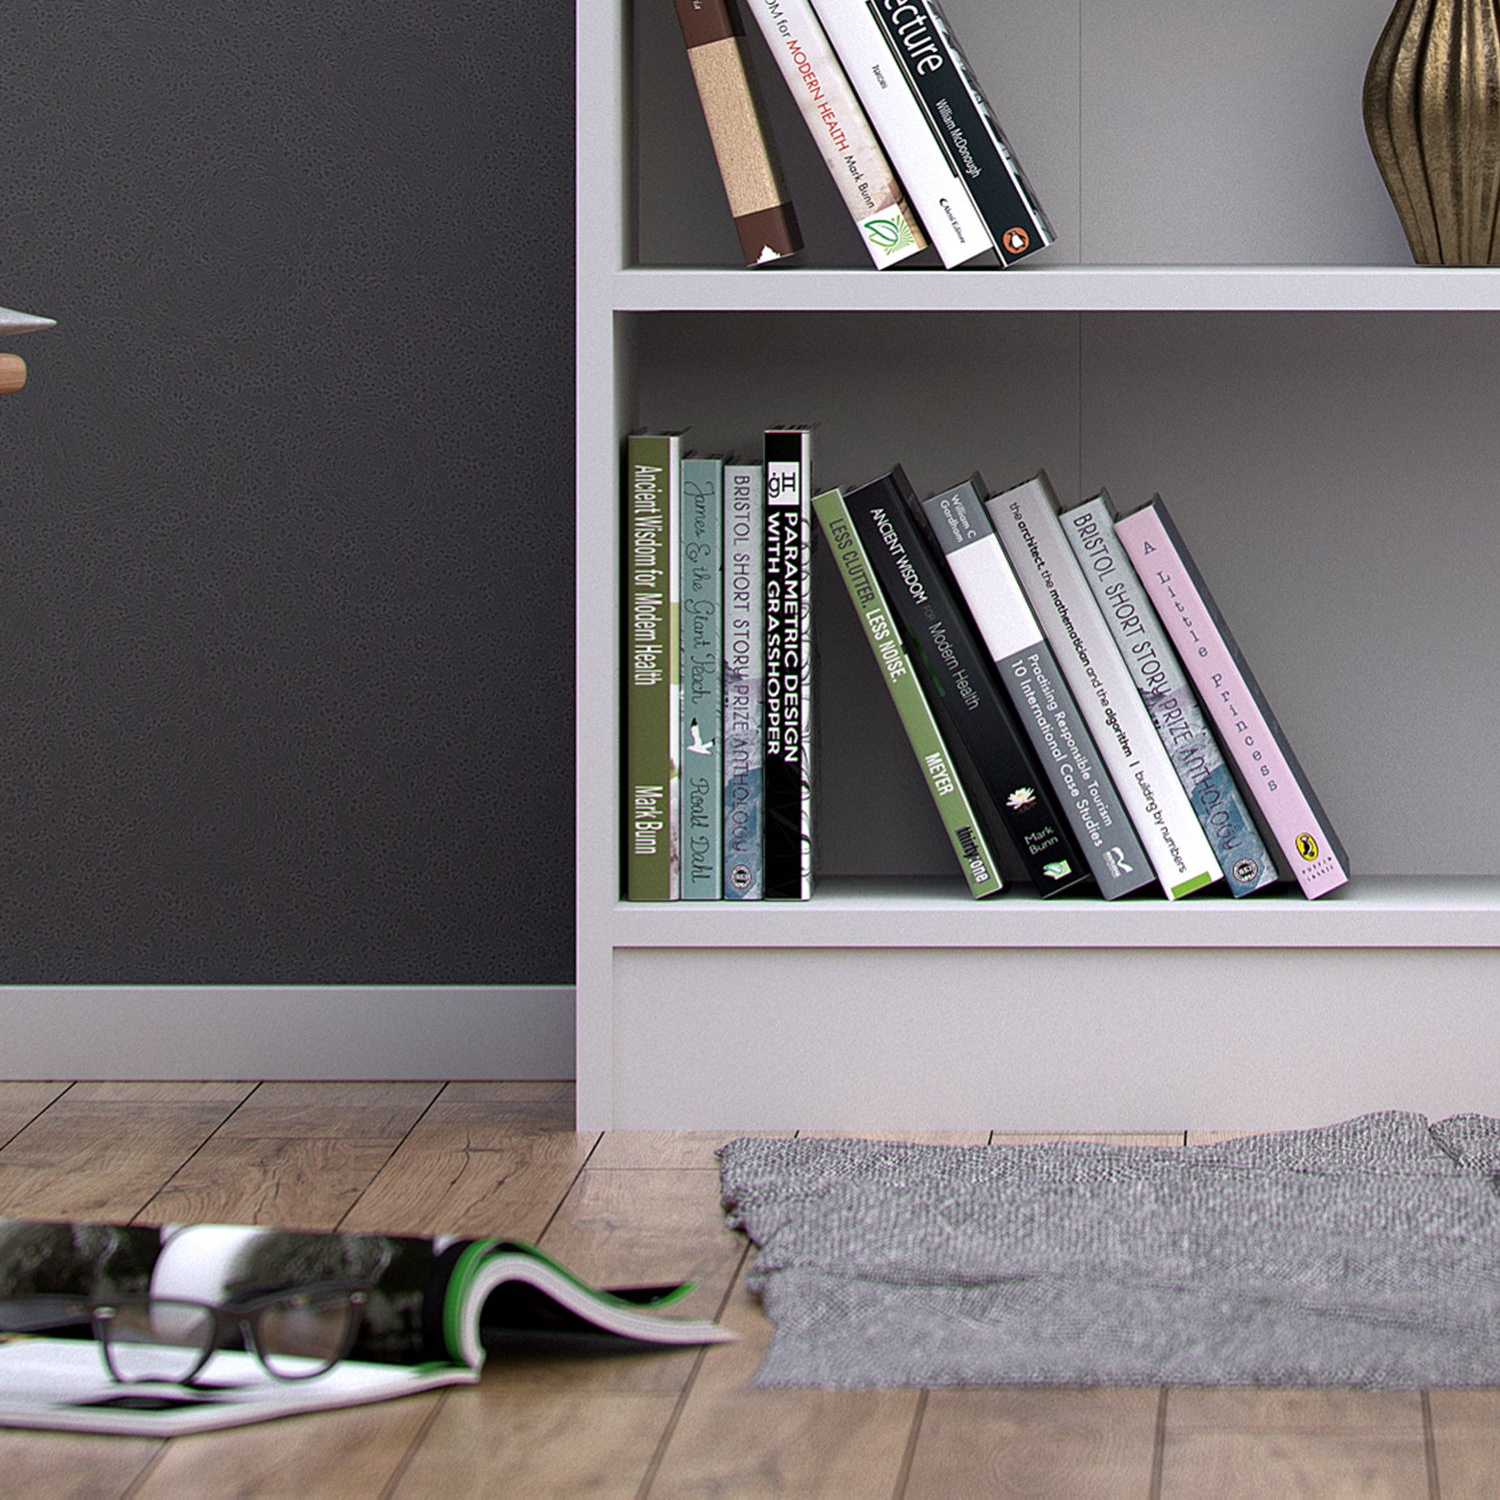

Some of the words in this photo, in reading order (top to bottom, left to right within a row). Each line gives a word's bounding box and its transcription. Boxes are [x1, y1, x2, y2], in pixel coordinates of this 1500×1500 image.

[777, 19, 791, 38] for
[786, 39, 825, 101] MODERN
[817, 102, 849, 152] HEALTH
[844, 155, 862, 182] Mark
[858, 183, 875, 209] Bunn
[936, 98, 956, 131] William
[950, 128, 982, 178] McDonough
[634, 464, 663, 513] Ancient
[684, 481, 715, 539] James
[733, 475, 750, 545] BRISTOL
[634, 515, 663, 567] Wisdom
[870, 508, 905, 556] ANCIENT
[940, 500, 963, 543] Gardham
[952, 494, 970, 530] William
[967, 530, 976, 539] C
[768, 512, 780, 573] WITH
[634, 569, 663, 588] for
[692, 566, 711, 592] the
[733, 553, 750, 612] SHORT
[784, 512, 798, 668] PARAMETRIC
[829, 518, 853, 550] LESS
[842, 550, 875, 608] CLUTTER.
[865, 608, 890, 641] LESS
[879, 640, 907, 683] NOISE.
[895, 554, 928, 604] WISDOM
[634, 593, 663, 642] Modern
[685, 599, 715, 649] Giant
[922, 604, 936, 622] FOR
[634, 644, 663, 686] Health
[732, 618, 749, 681] STORY
[768, 581, 780, 755] GRASSHOPPER
[928, 621, 960, 670] Modern
[1143, 540, 1156, 555] A
[1156, 570, 1208, 658] Little
[1211, 673, 1278, 792] Princess
[691, 653, 715, 705] Peach
[952, 669, 980, 711] Health
[1009, 502, 1023, 521] the
[1018, 520, 1045, 571] architect,
[1041, 570, 1054, 589] the
[1049, 588, 1090, 667] mathematician
[1086, 667, 1102, 688] and
[1096, 688, 1110, 707] the
[1105, 707, 1132, 758] algorithm
[1134, 770, 1158, 813] building
[1153, 809, 1165, 825] by
[1160, 826, 1187, 873] numbers
[1073, 513, 1116, 582] BRISTOL
[1105, 582, 1146, 638] SHORT
[1132, 641, 1172, 696] STORY
[1159, 697, 1193, 745] PRIZE
[1180, 746, 1242, 850] ANTHOLOGY
[732, 685, 749, 730] PRIZE
[784, 675, 798, 762] DESIGN
[1011, 660, 1027, 677] 10
[1020, 679, 1068, 762] International
[1060, 763, 1080, 797] Case
[1076, 799, 1103, 847] Studies
[1028, 653, 1058, 711] Practising
[1054, 711, 1092, 780] Responsible
[1087, 780, 1113, 827] Tourism
[732, 738, 749, 852] ANTHOLOGY
[925, 752, 954, 796] MEYER
[635, 786, 663, 819] Mark
[690, 777, 709, 829] Roald
[635, 821, 663, 855] Bunn
[690, 836, 713, 884] Dahl
[1024, 826, 1054, 846] Mark
[1029, 836, 1059, 855] Bunn
